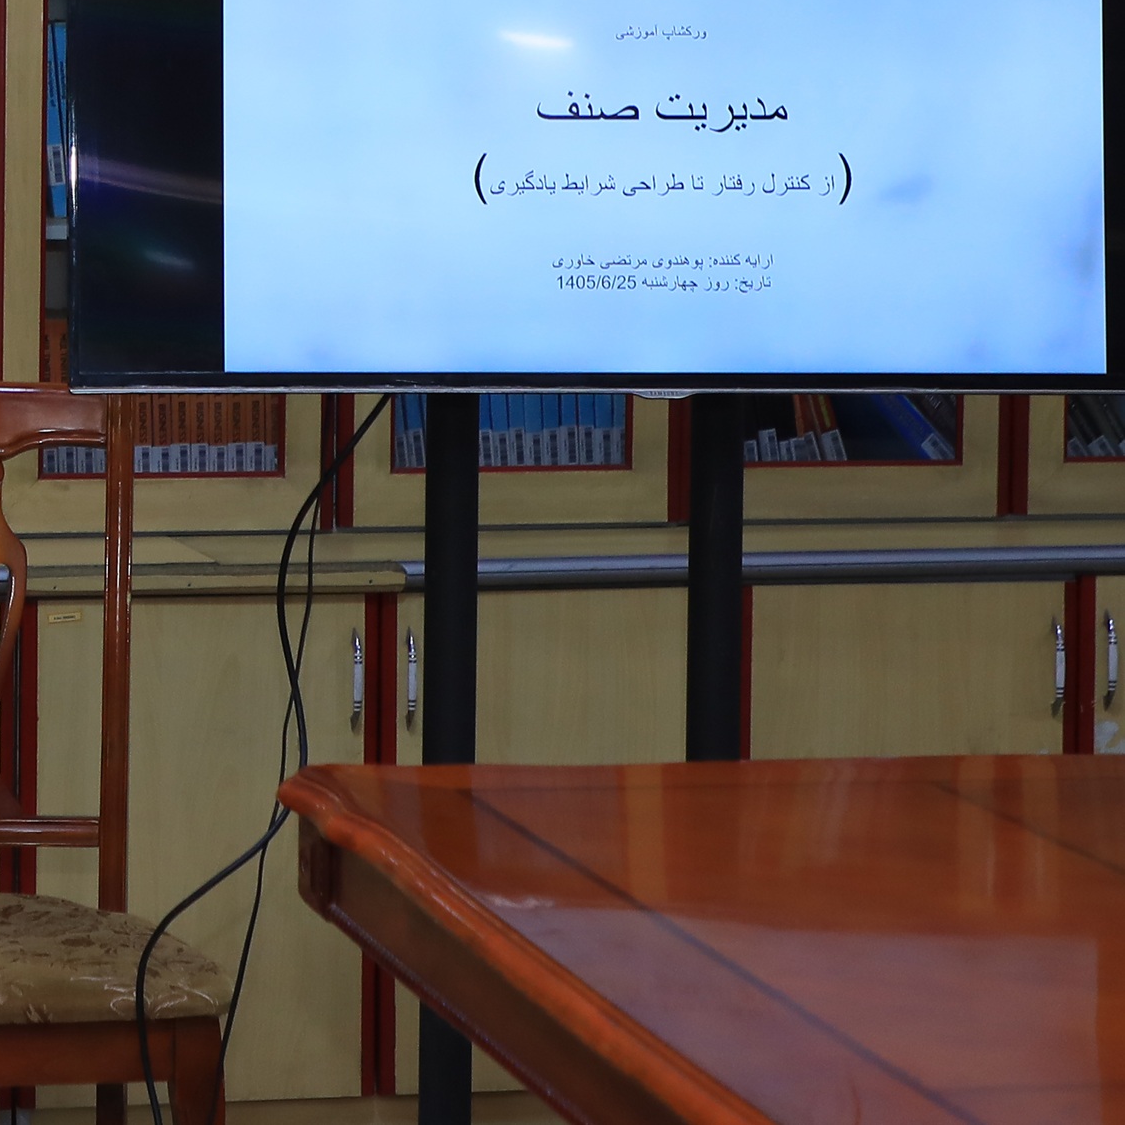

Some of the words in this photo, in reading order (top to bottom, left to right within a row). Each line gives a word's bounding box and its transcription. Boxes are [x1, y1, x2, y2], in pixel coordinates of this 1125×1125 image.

[662, 25, 707, 40] ورکشاپ
[537, 91, 639, 121] صنف
[655, 93, 788, 132] مدیریت
[561, 173, 617, 196] شرایط
[622, 173, 685, 196] طراحی
[691, 174, 704, 191] تا
[711, 174, 755, 196] رفتار
[761, 173, 811, 196] کنترل
[552, 253, 595, 270] خاوری
[600, 255, 648, 270] مرتضی
[651, 257, 704, 271] پوهندوی
[708, 253, 741, 266] کننده:
[745, 253, 774, 270] ارایه
[557, 275, 637, 290] 1405/6/25
[641, 276, 698, 293] چهارشنبه
[703, 279, 729, 291] روز
[734, 275, 772, 293] تاریخ:
